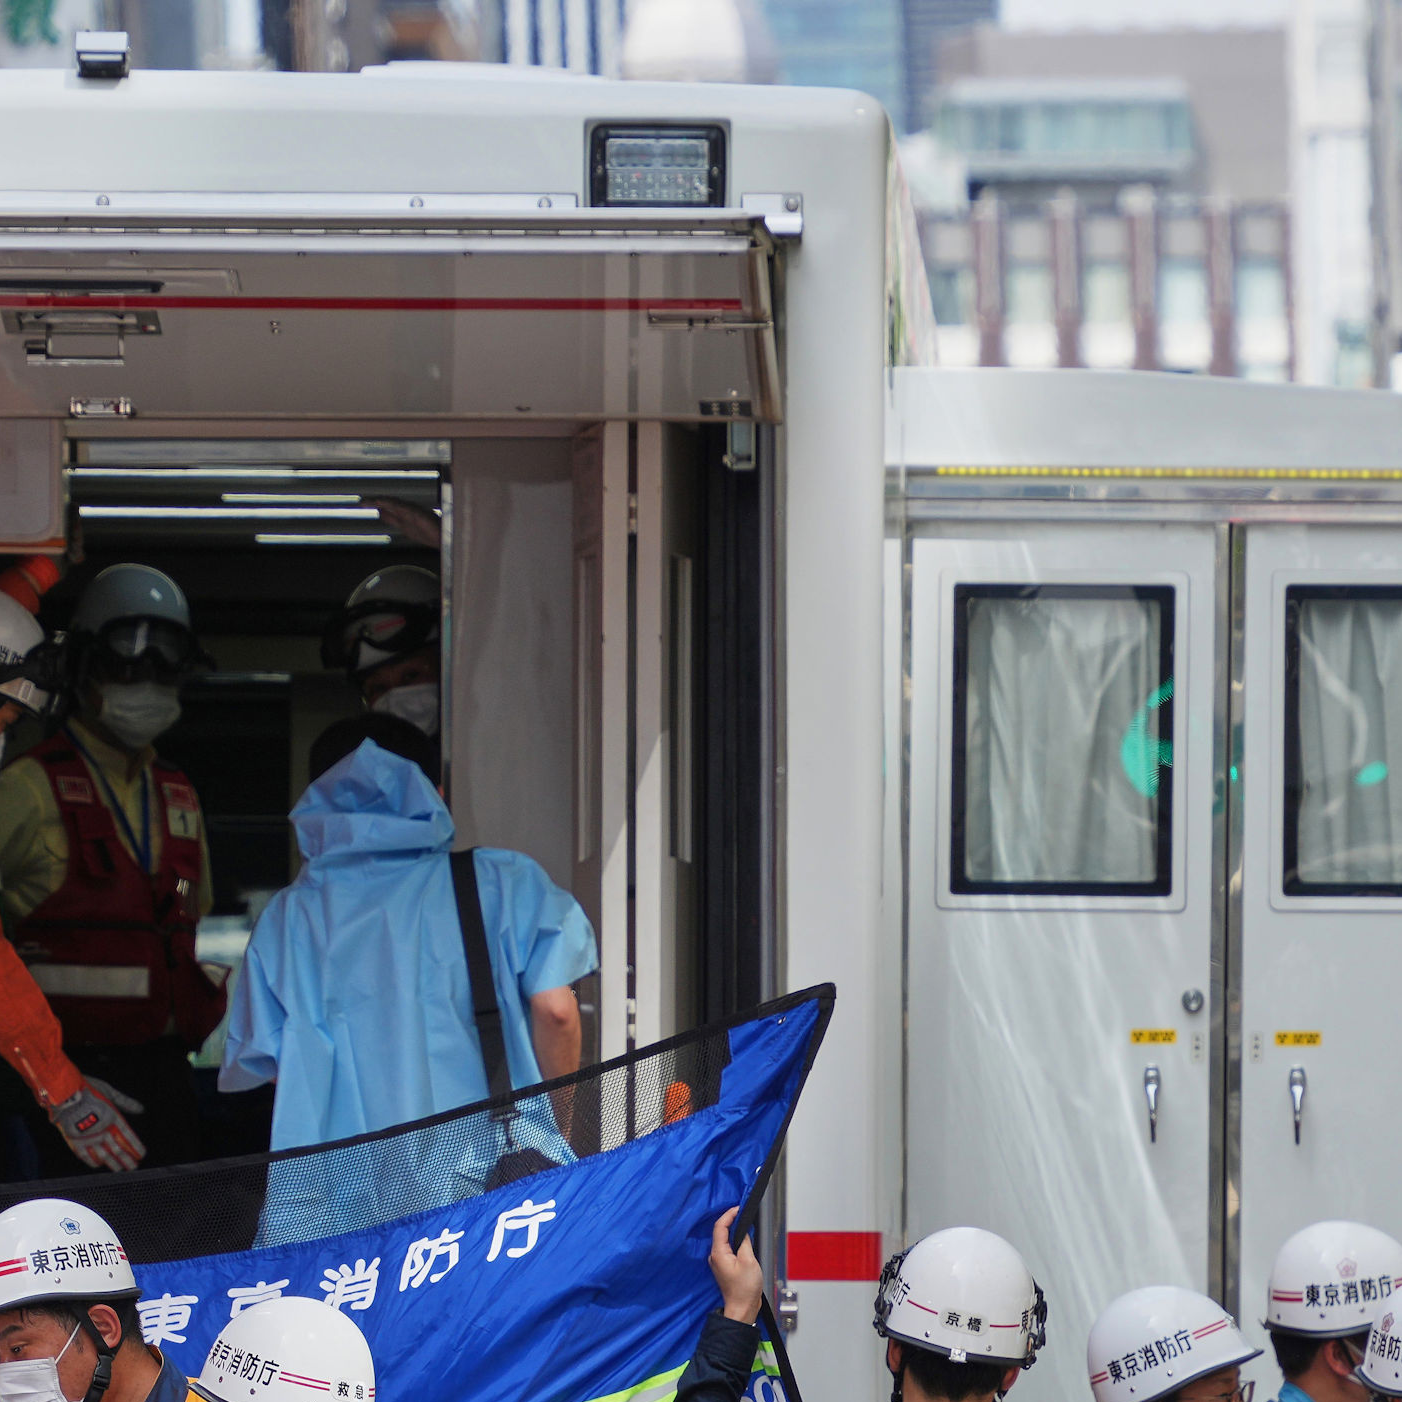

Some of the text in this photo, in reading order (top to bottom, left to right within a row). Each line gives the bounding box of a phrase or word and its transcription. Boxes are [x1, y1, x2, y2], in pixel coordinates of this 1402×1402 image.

[29, 1241, 120, 1276] 東京消防庁
[1305, 1274, 1393, 1308] 東京消防庁
[945, 1311, 982, 1333] 京橋
[208, 1338, 282, 1388] 東京消防庁
[1107, 1329, 1194, 1385] 東京消防庁
[336, 1380, 365, 1401] 救急
